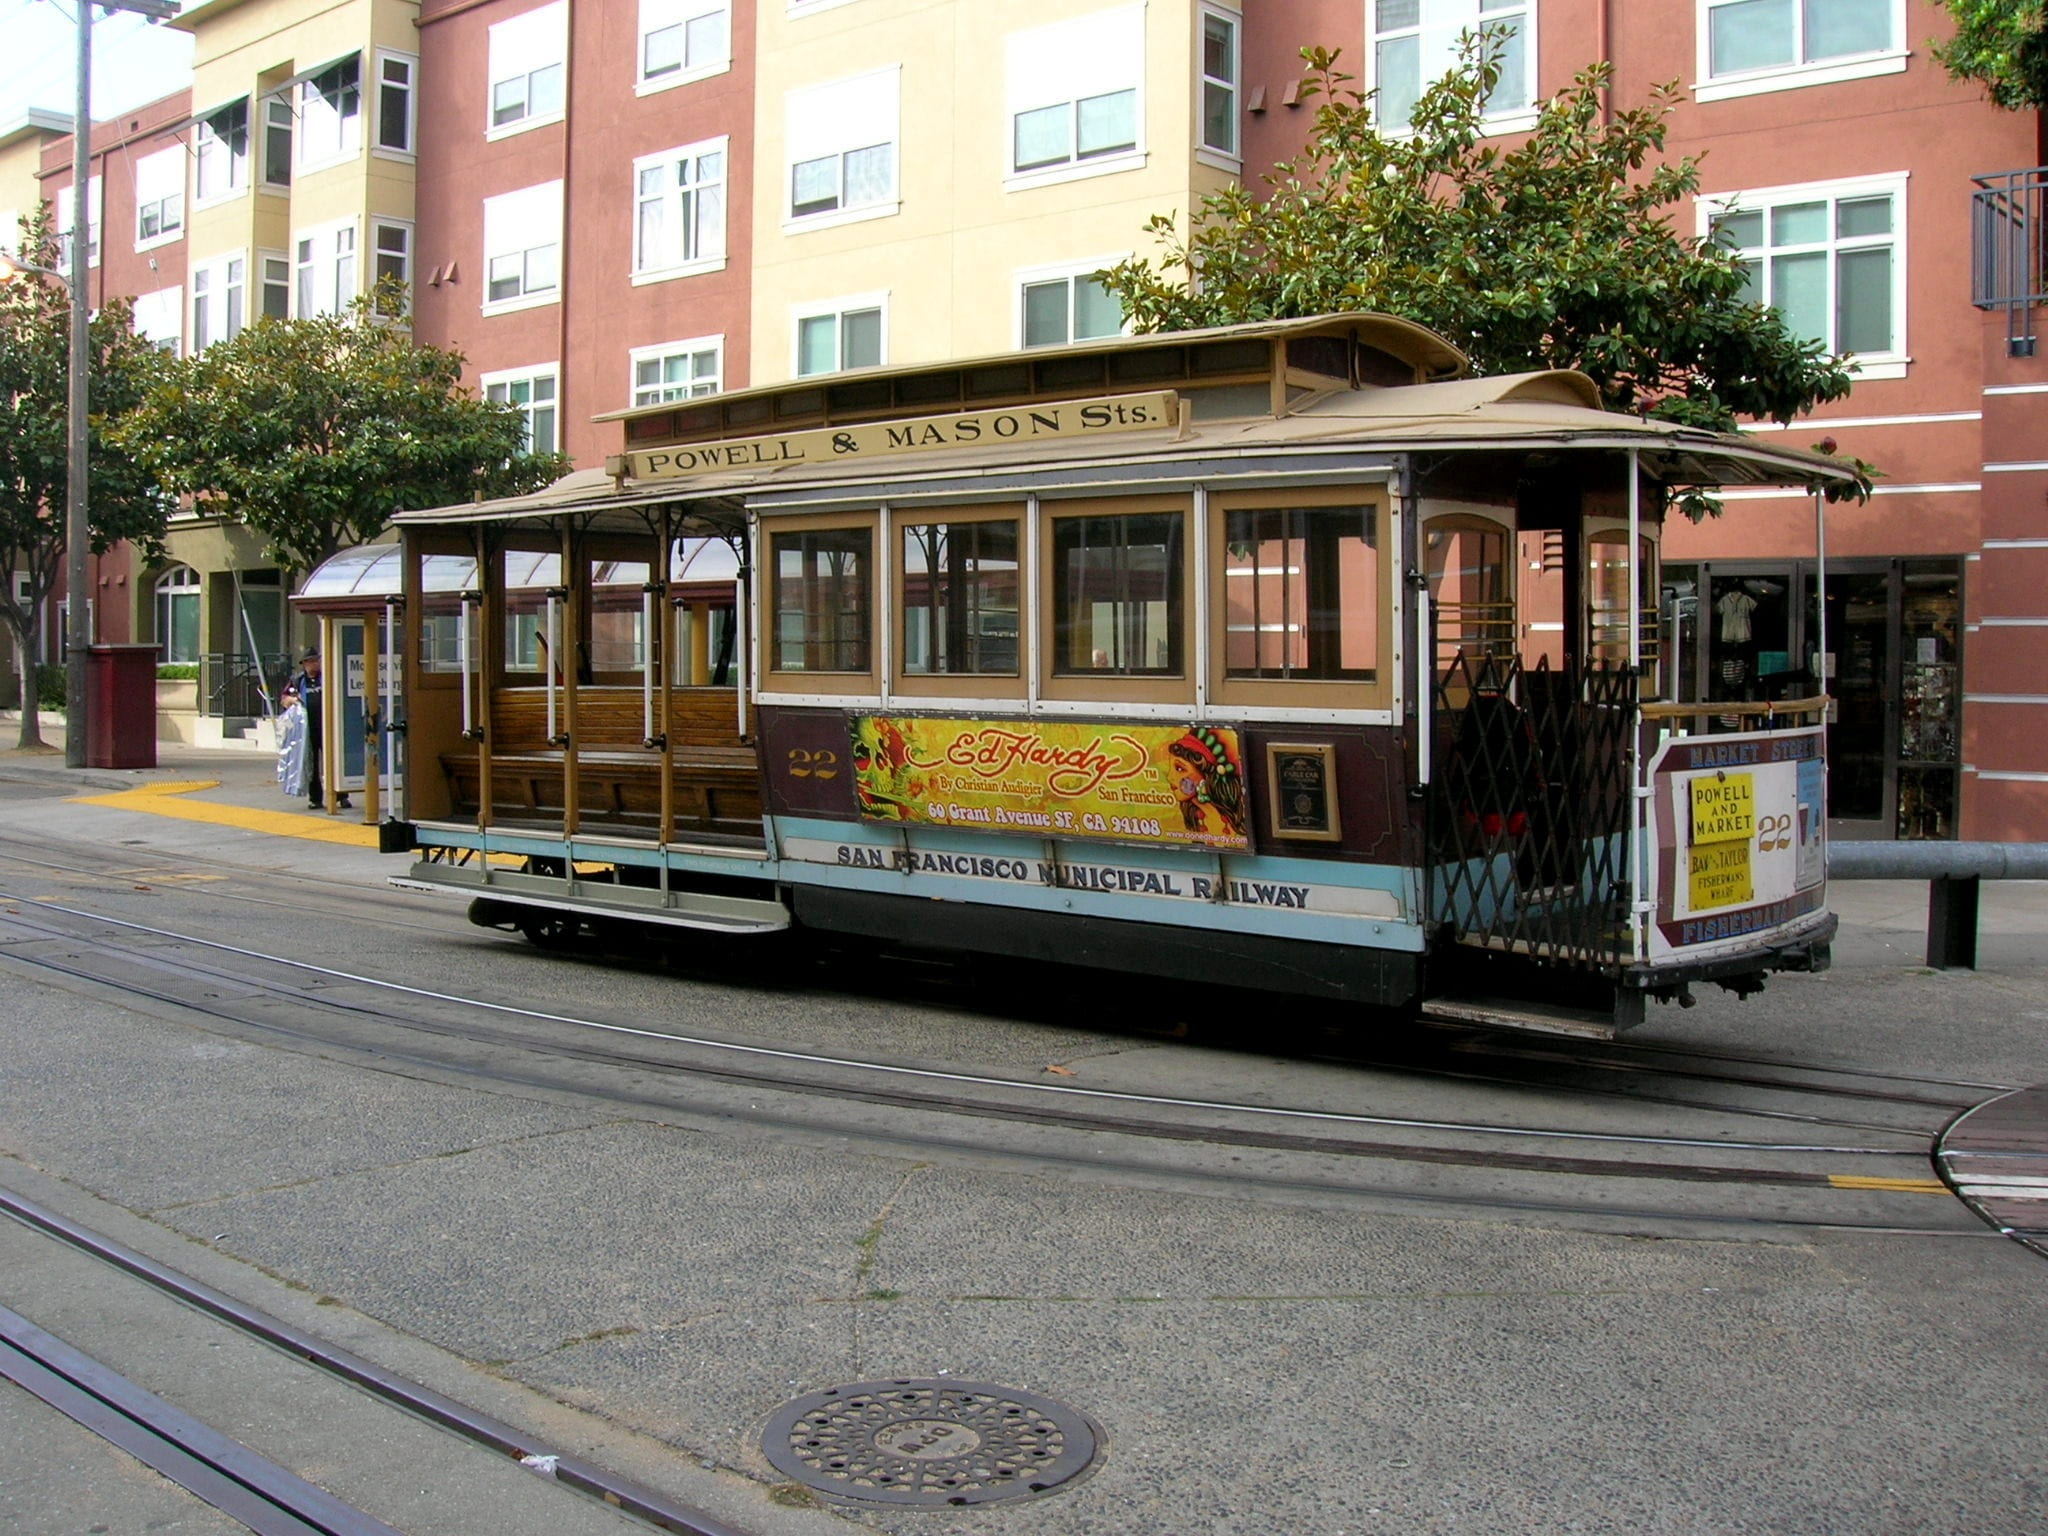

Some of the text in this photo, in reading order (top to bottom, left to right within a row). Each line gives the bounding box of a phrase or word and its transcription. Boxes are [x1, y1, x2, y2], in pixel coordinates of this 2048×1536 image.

[649, 404, 1157, 473] POWELL & MASON Sts.
[788, 748, 838, 780] 22
[945, 732, 1002, 767] Ed
[972, 727, 1147, 797] Hardy
[1691, 742, 1760, 769] MARKET
[939, 775, 1042, 799] By Christian Audigier
[1098, 786, 1175, 805] San Francisco
[1696, 785, 1750, 805] POWELL
[927, 801, 1162, 838] 60 Grant Avenue SF, CA 94108
[1696, 814, 1752, 836] MARKET
[1711, 802, 1738, 817] AND
[1758, 814, 1791, 853] 22
[837, 845, 885, 869] SAN
[891, 850, 1028, 882] FRANCISCO
